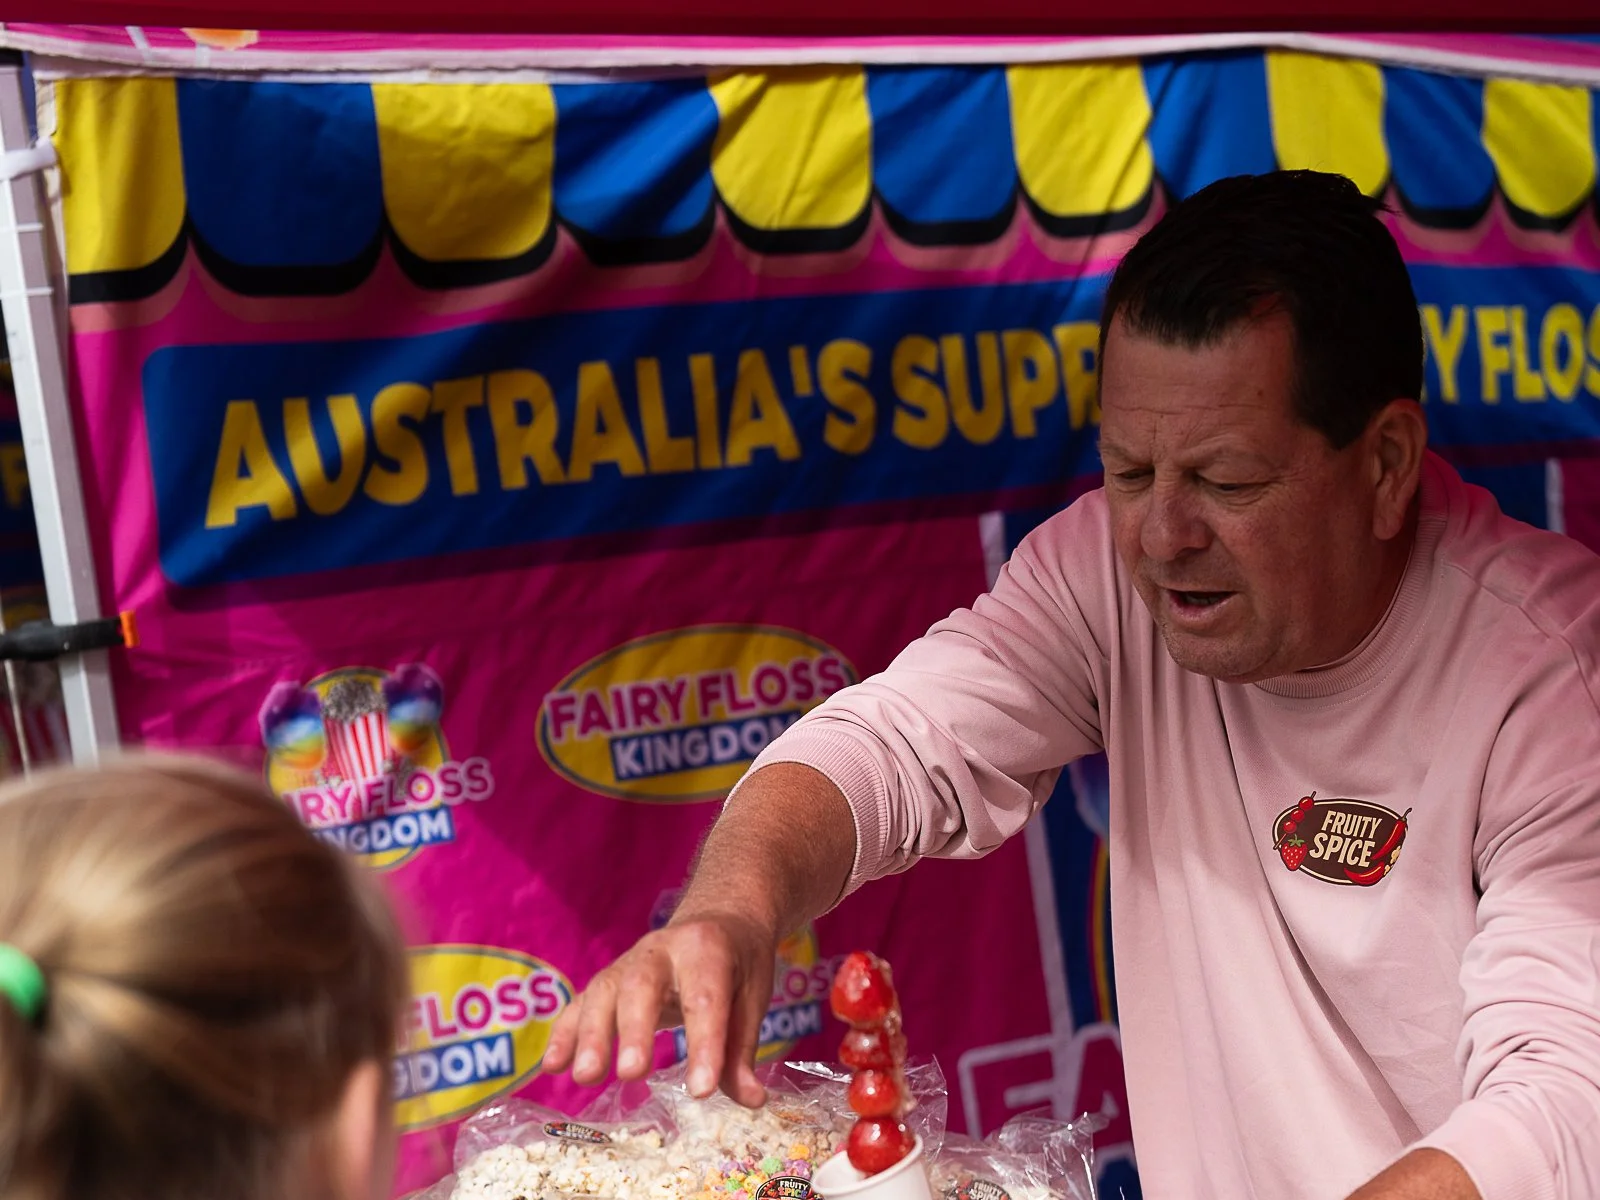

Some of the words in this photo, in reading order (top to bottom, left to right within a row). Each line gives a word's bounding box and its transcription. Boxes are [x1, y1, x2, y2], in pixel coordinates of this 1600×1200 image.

[205, 338, 876, 530] AUSTRALIA'S
[891, 320, 1102, 450] SUPR
[547, 678, 687, 741] FAIRY
[694, 653, 847, 718] FLOSS
[362, 759, 493, 815] FLOSS
[1321, 810, 1382, 839] FRUITY
[1309, 832, 1376, 868] SPICE
[778, 1187, 807, 1199] SPICE
[780, 1180, 808, 1190] FRUITY
[974, 1182, 1003, 1197] FRUITY
